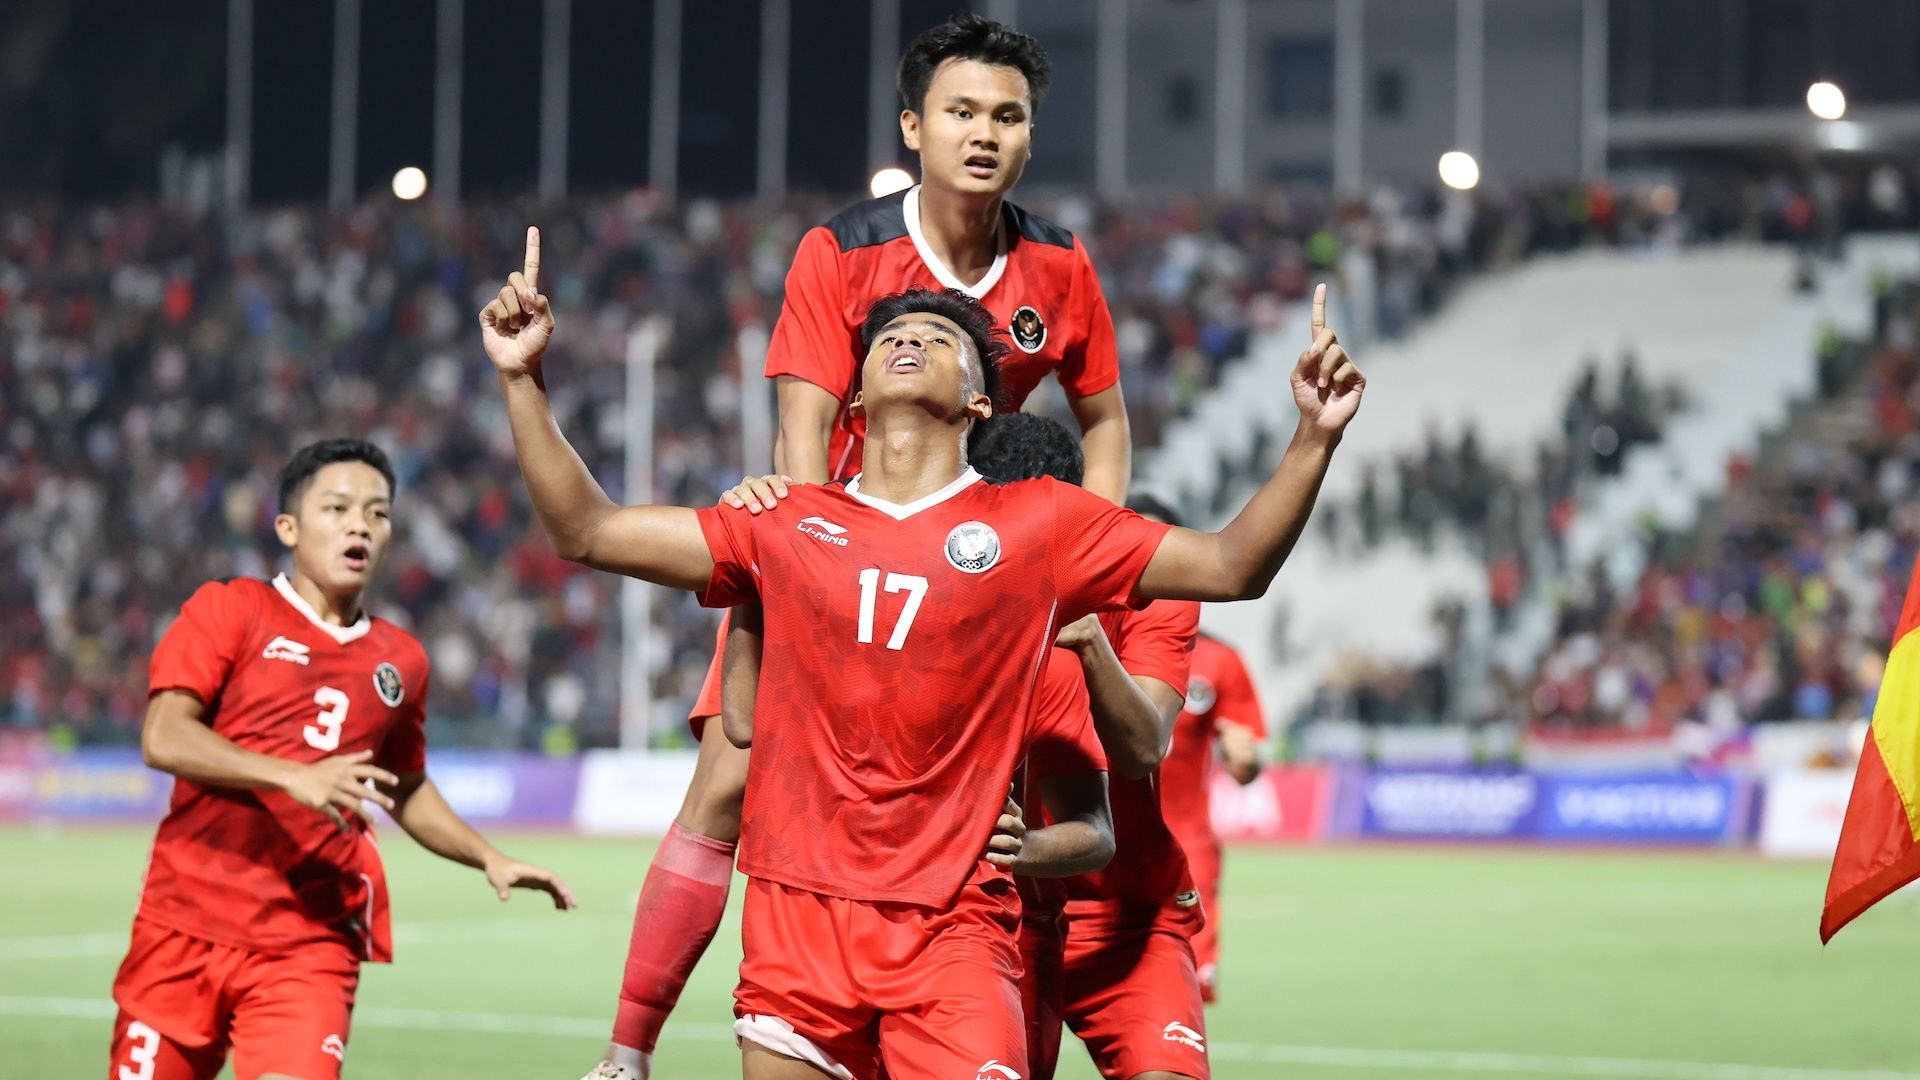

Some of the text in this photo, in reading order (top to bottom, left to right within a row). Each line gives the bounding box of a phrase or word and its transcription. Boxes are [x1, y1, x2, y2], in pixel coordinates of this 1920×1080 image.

[796, 522, 849, 547] LI-NING
[857, 567, 929, 651] 17
[303, 686, 350, 752] 3
[118, 1020, 161, 1080] 3
